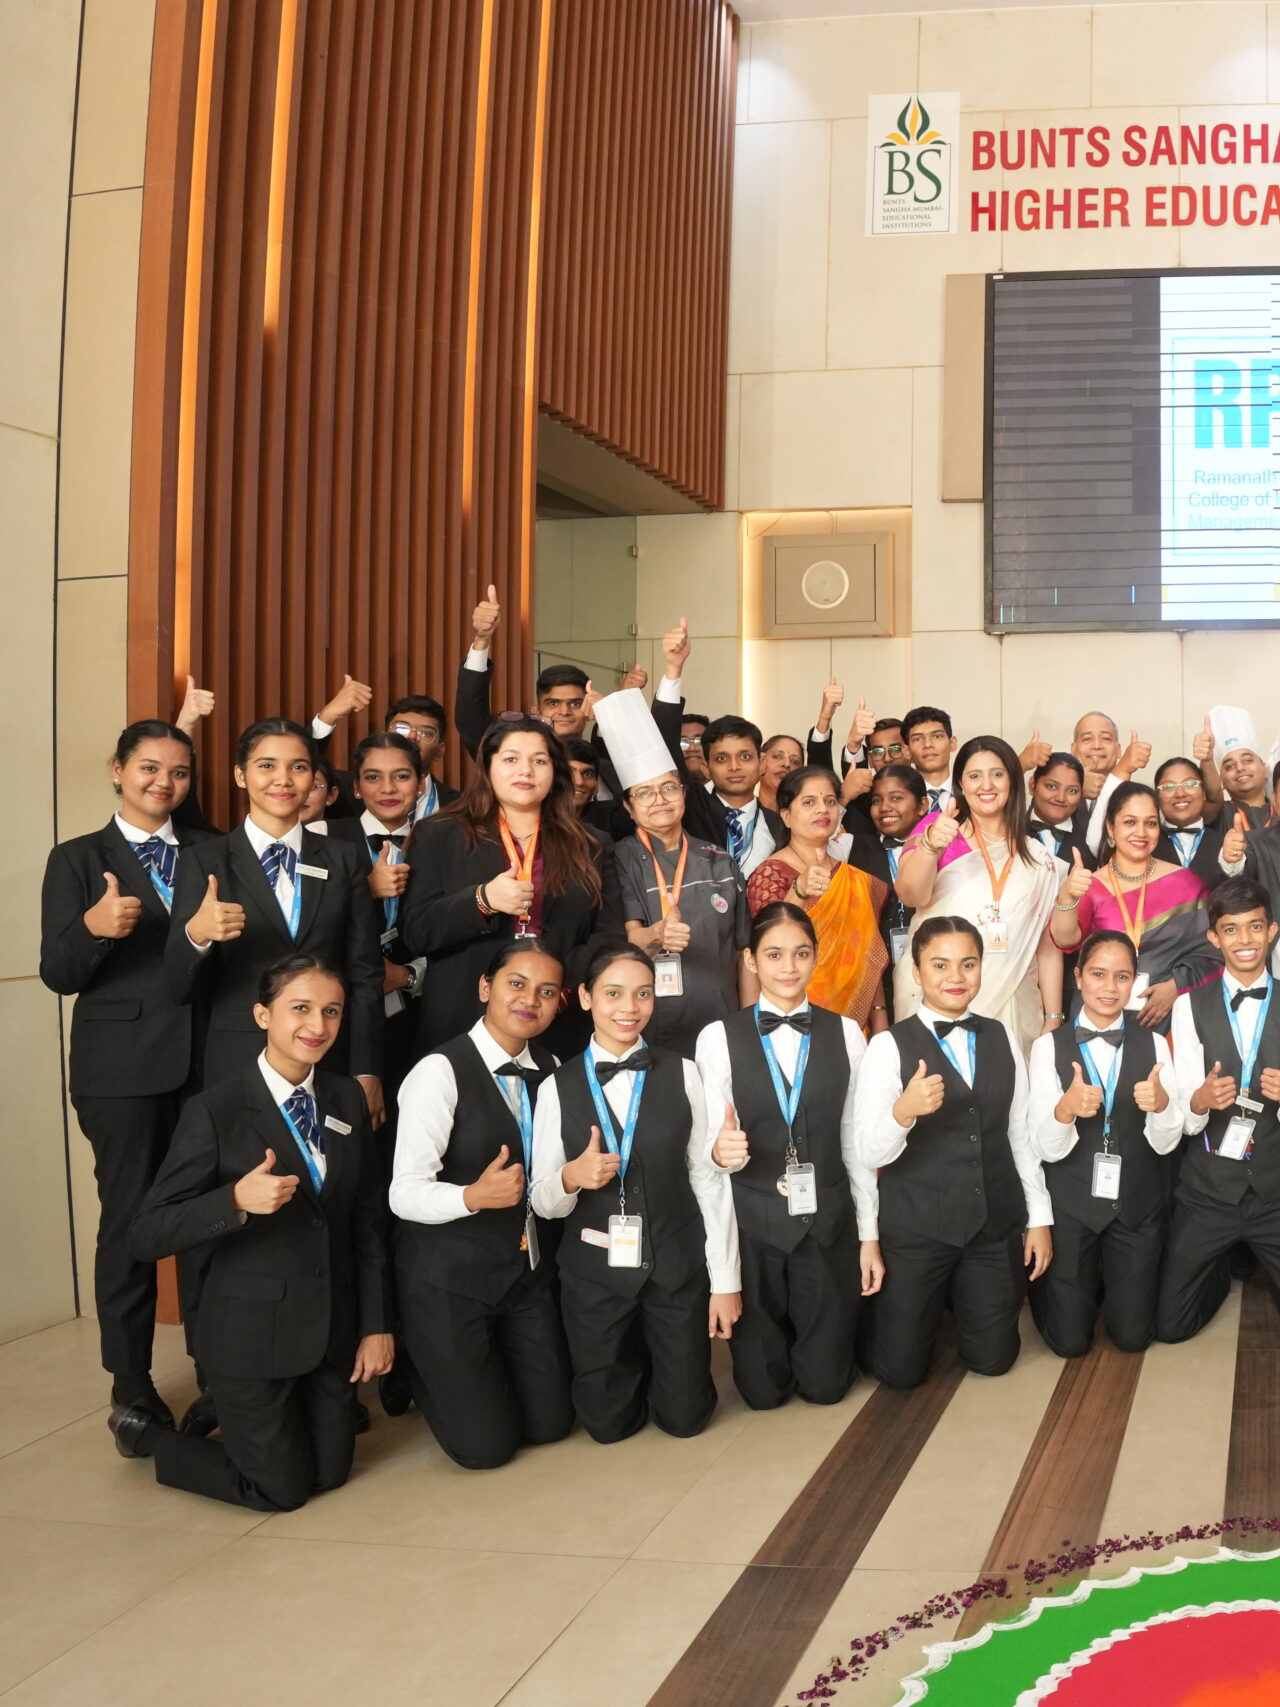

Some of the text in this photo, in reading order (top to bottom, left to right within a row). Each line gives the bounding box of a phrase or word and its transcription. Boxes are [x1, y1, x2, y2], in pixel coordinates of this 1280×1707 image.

[972, 126, 1110, 171] BUNTS
[883, 149, 942, 203] BS
[971, 187, 1131, 232] HIGHER
[1193, 469, 1277, 485] Ramanath
[1188, 491, 1250, 509] College
[1254, 491, 1271, 507] of
